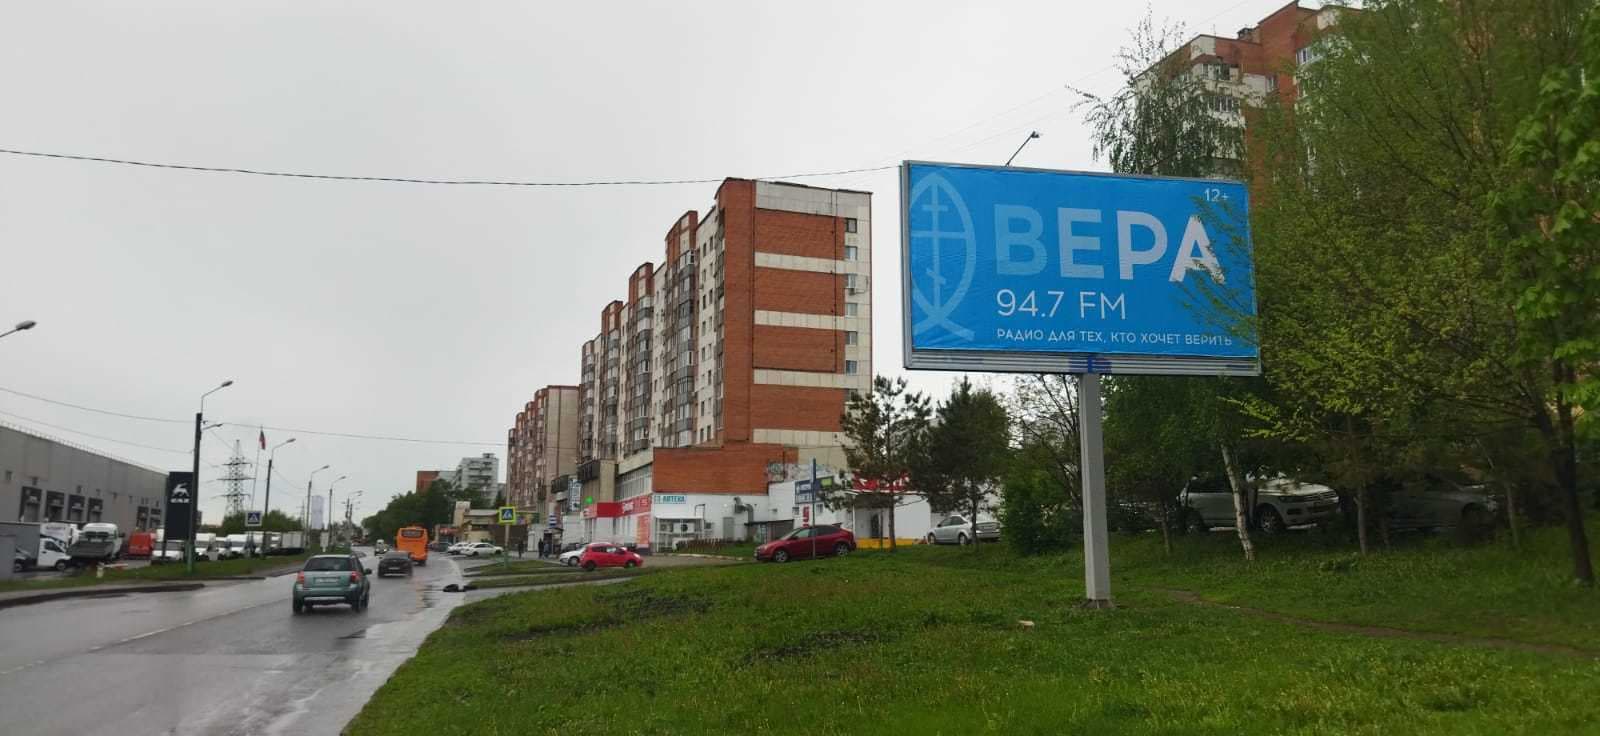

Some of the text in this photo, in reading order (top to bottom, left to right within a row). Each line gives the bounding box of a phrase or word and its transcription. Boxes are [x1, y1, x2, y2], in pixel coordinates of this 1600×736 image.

[1204, 188, 1229, 203] 12+
[993, 203, 1225, 285] ВЕРА
[996, 288, 1127, 321] 94.7 FM
[997, 328, 1233, 346] РАДИО ДЛЯ ТЕХ, КТО ХОЧЕТ ВЕРИТЬ
